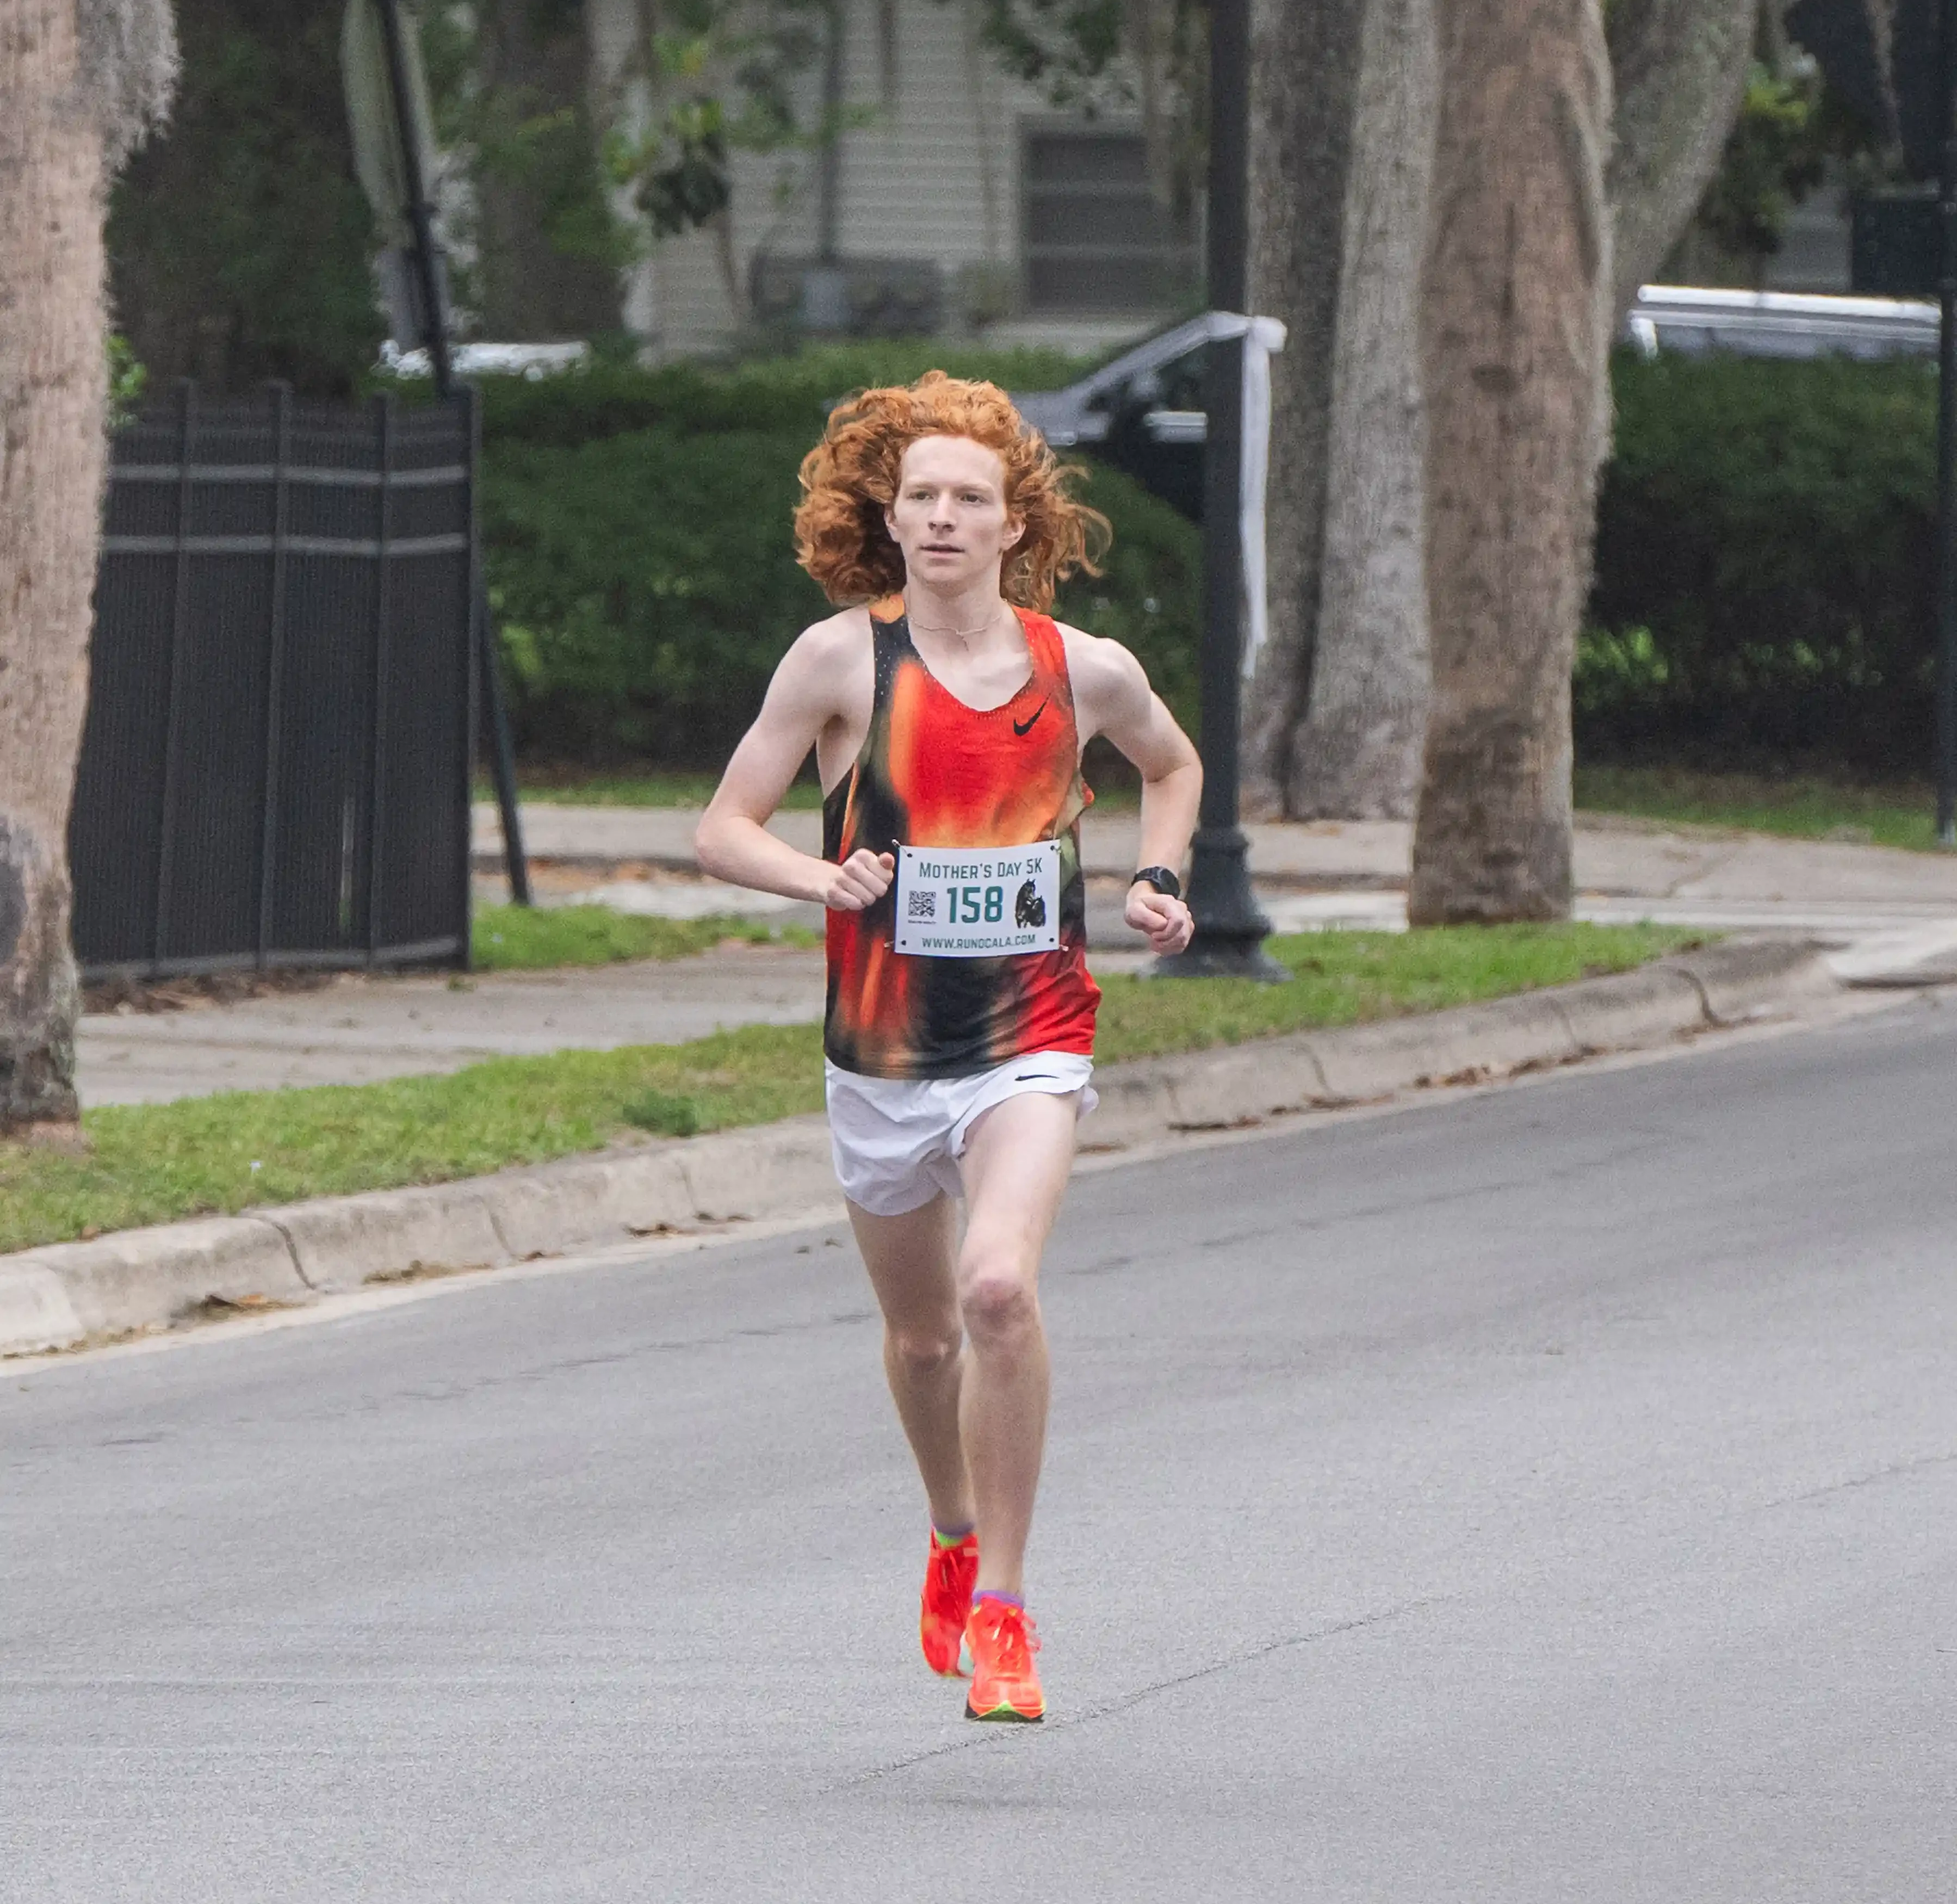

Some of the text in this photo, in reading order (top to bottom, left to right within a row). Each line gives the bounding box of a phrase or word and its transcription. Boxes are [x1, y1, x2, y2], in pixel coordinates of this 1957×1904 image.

[919, 857, 1043, 879] MOTHER'S DAY 5K
[946, 886, 1003, 924] 158
[921, 934, 1036, 949] WWW.RUNOCALA.COM
